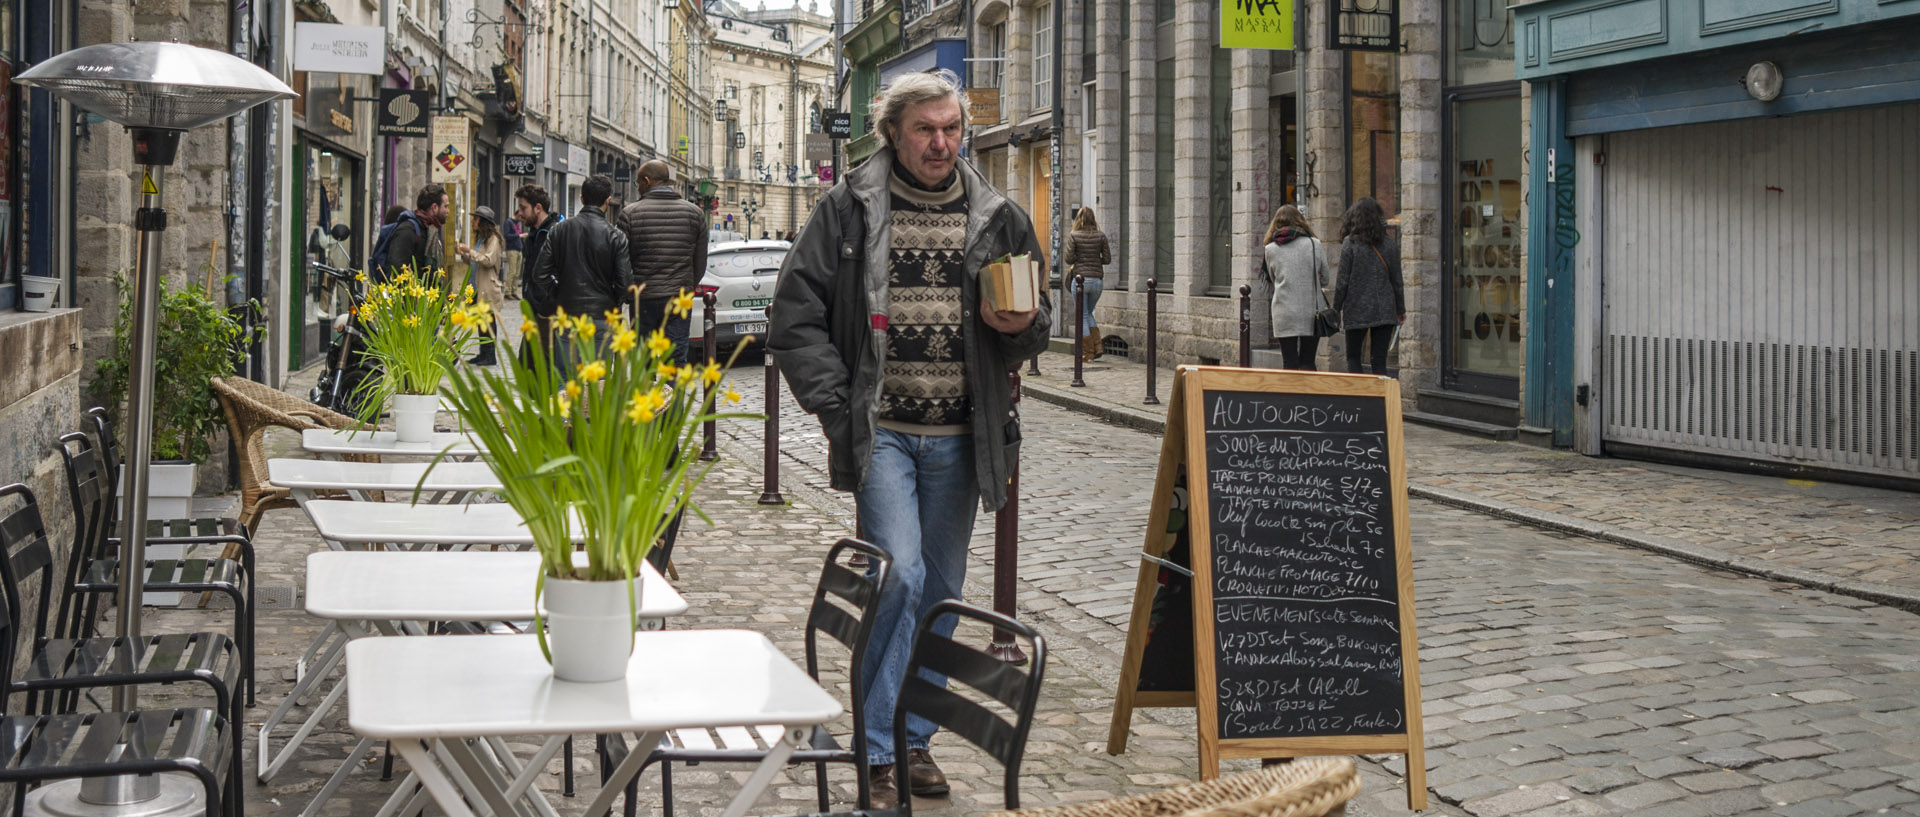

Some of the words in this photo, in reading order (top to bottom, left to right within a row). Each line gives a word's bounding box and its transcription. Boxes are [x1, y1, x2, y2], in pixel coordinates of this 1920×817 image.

[1235, 17, 1282, 26] MASSAI
[1235, 25, 1282, 33] MARA
[1338, 36, 1391, 46] SHOE-SHOP
[379, 125, 405, 133] SUPREME
[1460, 311, 1521, 342] LOVE
[1217, 435, 1267, 454] SOUPE
[1290, 437, 1344, 457] JOUR
[1211, 470, 1256, 482] TARTE
